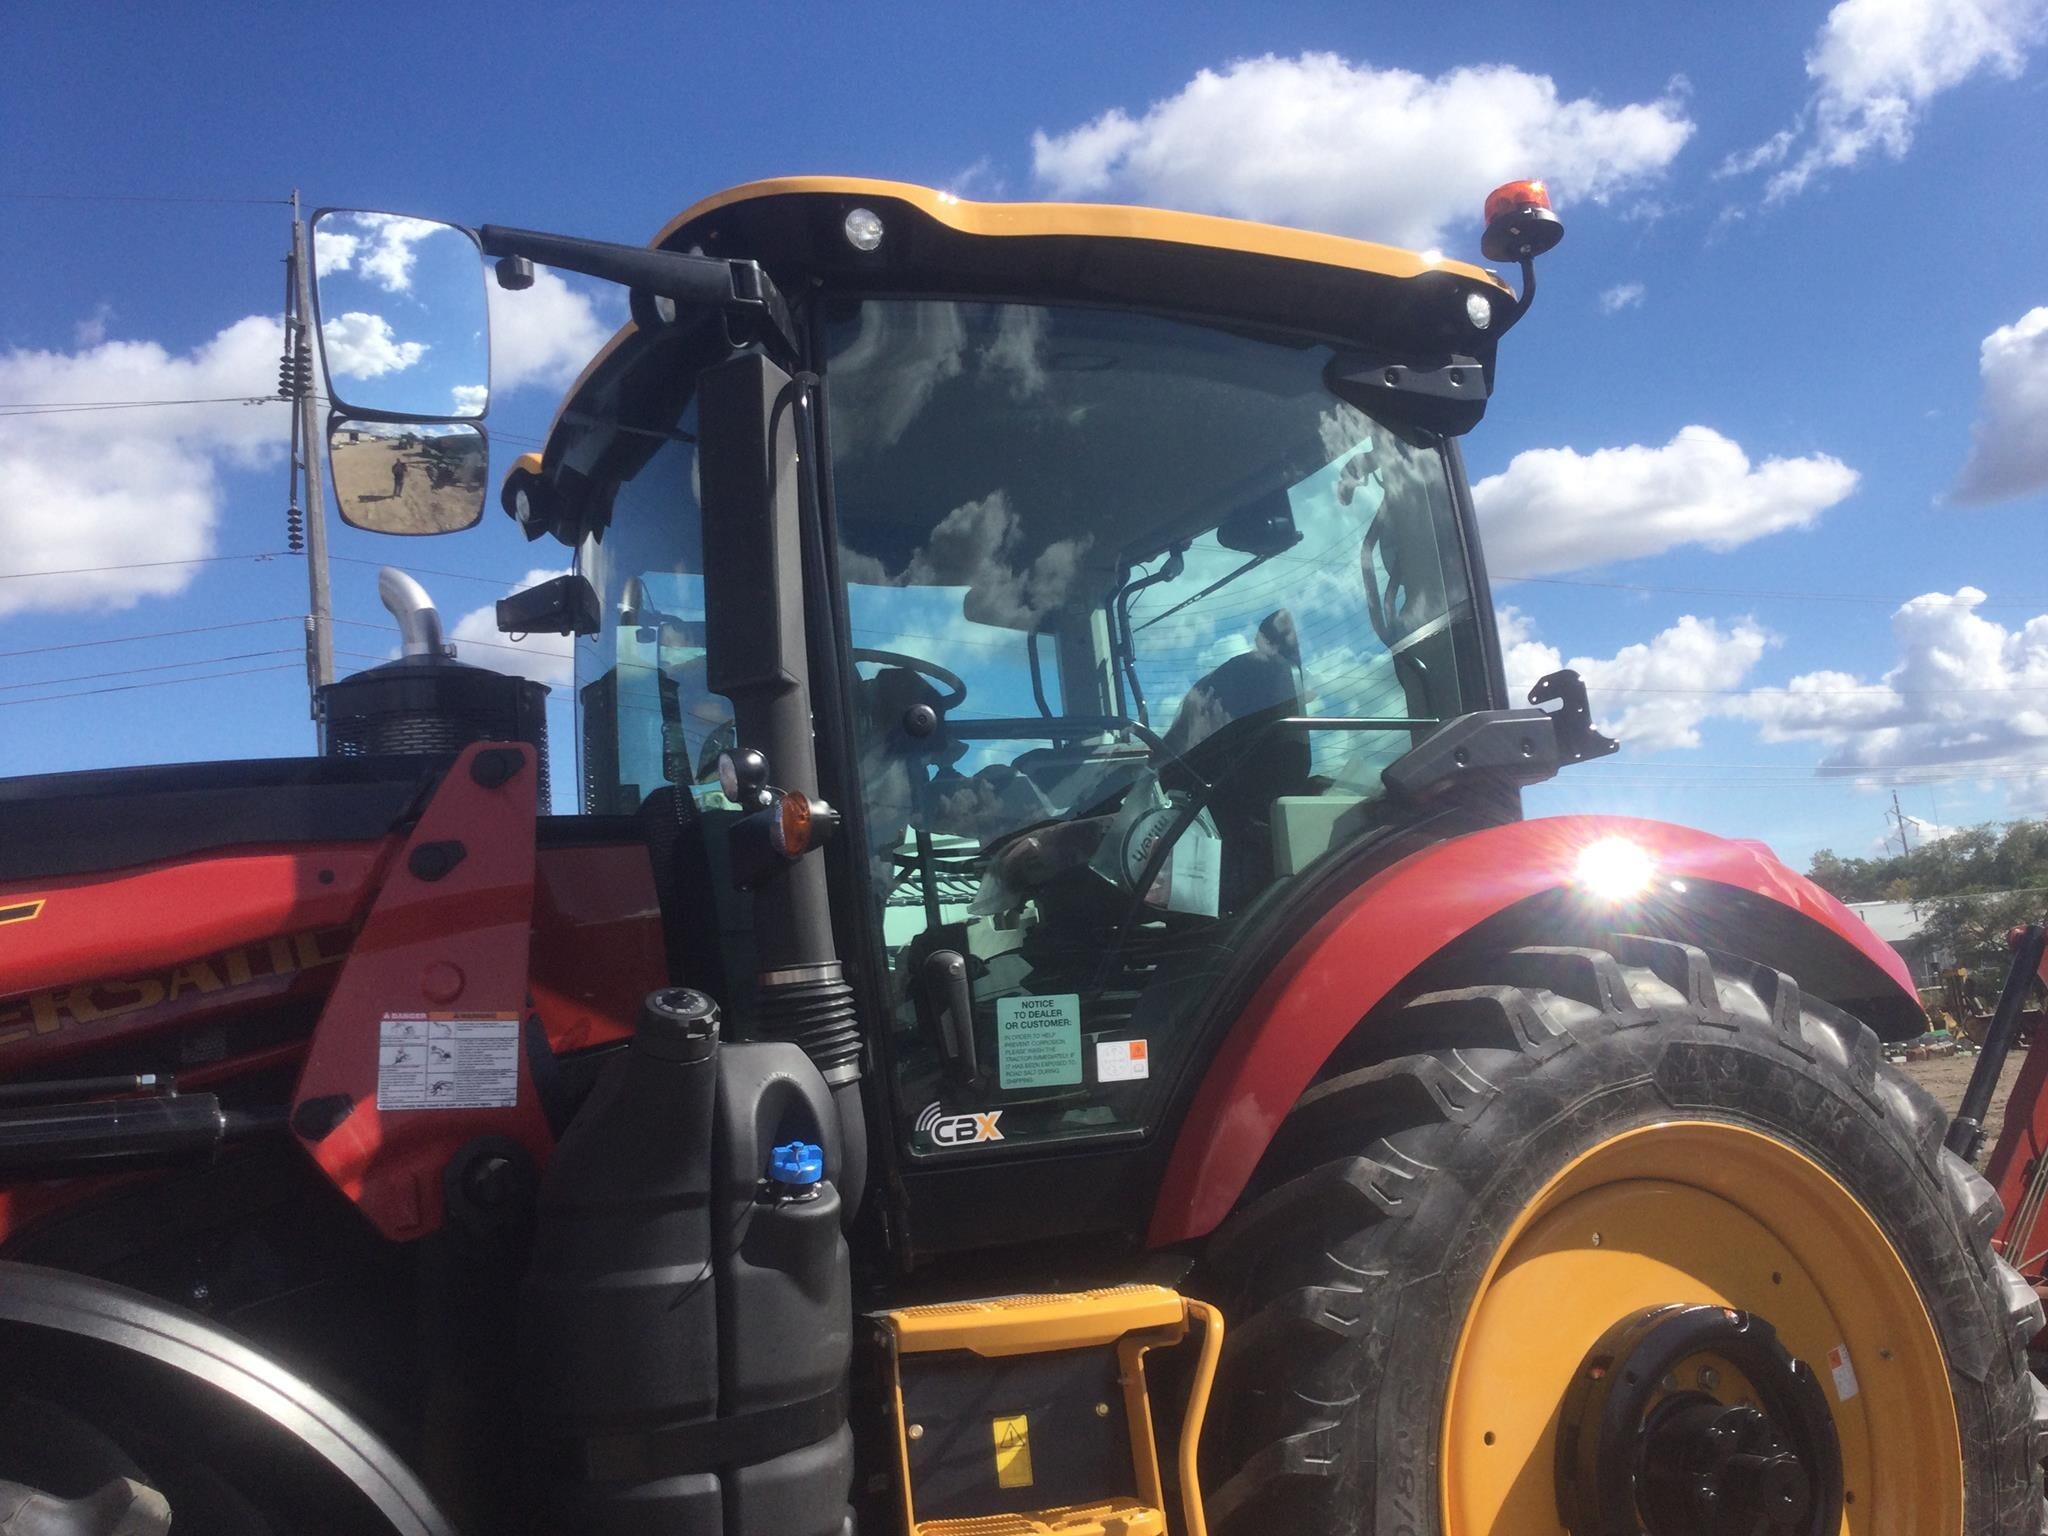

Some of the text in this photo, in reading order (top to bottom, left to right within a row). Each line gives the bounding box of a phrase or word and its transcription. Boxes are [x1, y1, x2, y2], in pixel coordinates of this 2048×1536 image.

[1021, 1000, 1055, 1009] NOTICE
[1014, 1009, 1063, 1020] TO DEALER
[1005, 1018, 1072, 1030] OR CUSTOMER:
[932, 1110, 1005, 1146] CBX
